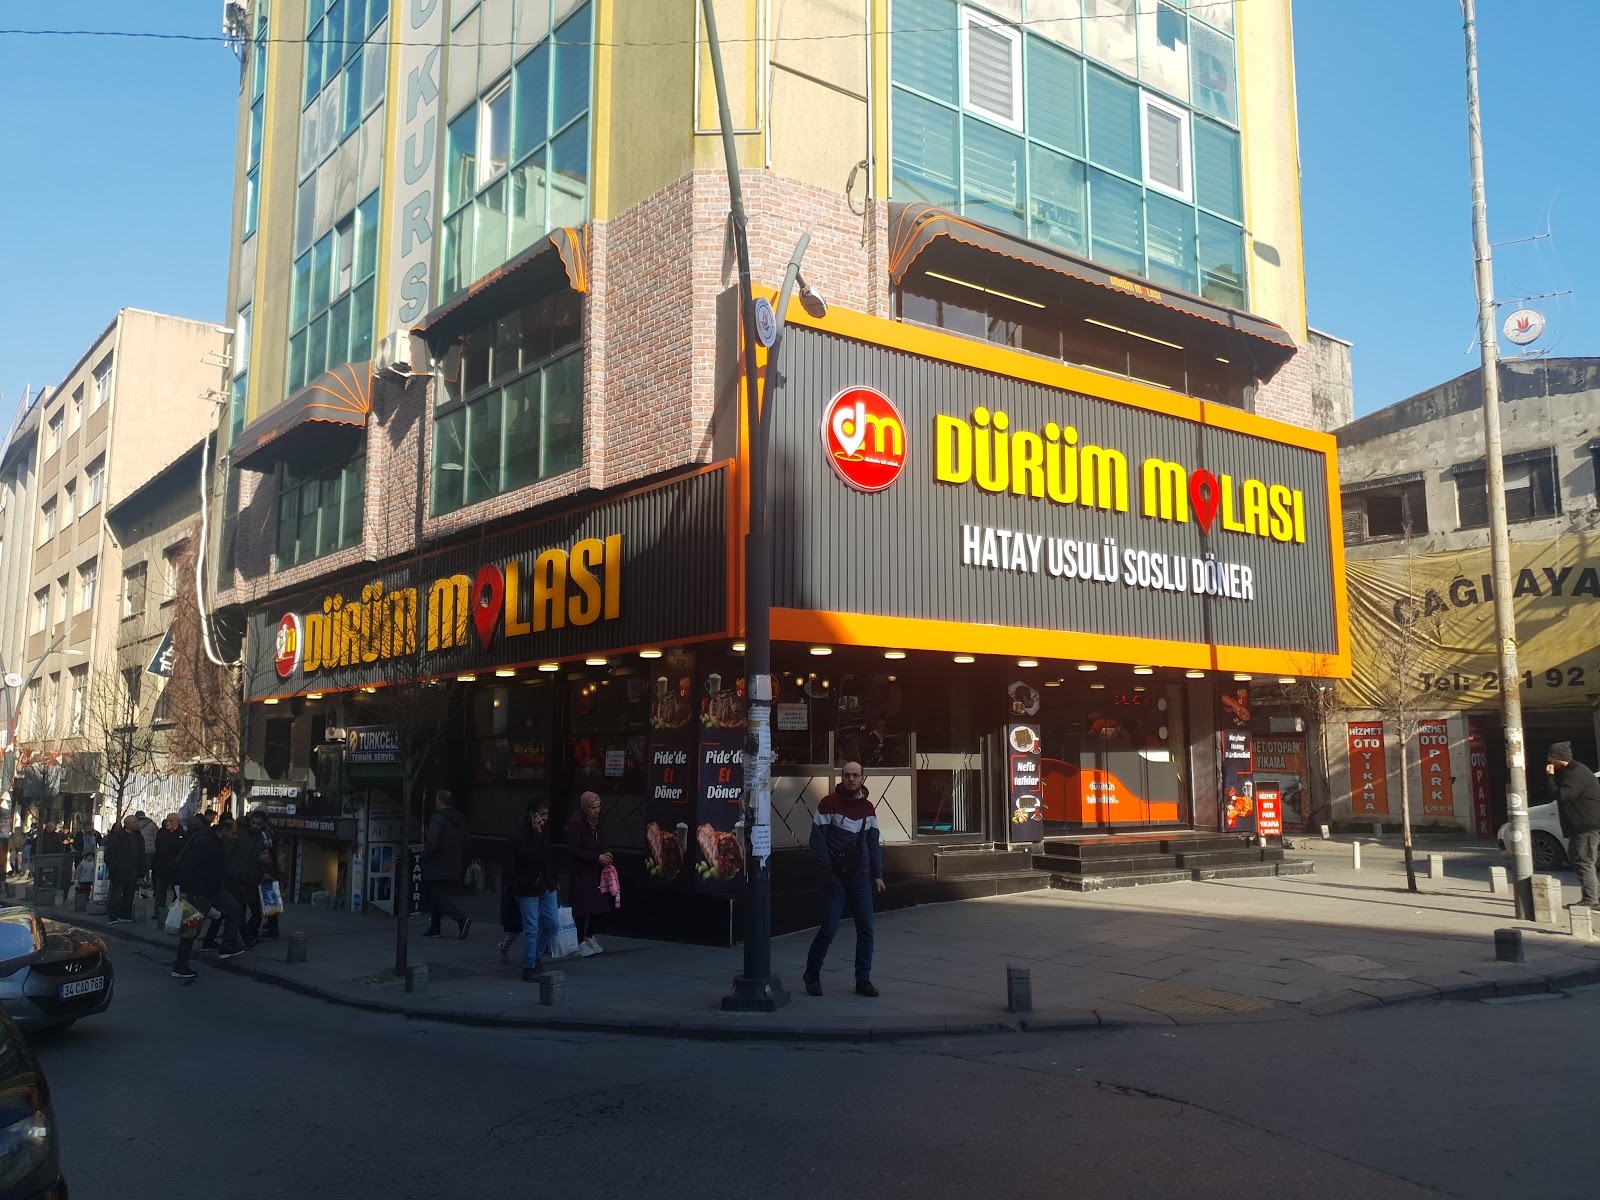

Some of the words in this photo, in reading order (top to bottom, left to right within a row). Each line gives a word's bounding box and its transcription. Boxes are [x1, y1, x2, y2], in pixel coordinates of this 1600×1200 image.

[934, 406, 1128, 513] DÜRÜM
[962, 524, 1042, 574] HATAY
[1048, 537, 1119, 583] USULÜ
[1123, 548, 1187, 593] SOSLU
[1192, 552, 1254, 600] DÖNER
[303, 581, 417, 672] DÜRÜM
[1545, 666, 1585, 687] 92
[1348, 726, 1383, 736] HİZMET
[1418, 723, 1447, 733] HİZMET
[1353, 738, 1380, 748] OTO
[1420, 735, 1448, 745] OTO
[1267, 741, 1301, 754] OTOPARK
[352, 752, 373, 762] TEKNİK
[374, 751, 395, 761] SERVİS
[653, 750, 687, 764] Pide'de
[1256, 756, 1286, 769] YIKAMA
[1471, 752, 1486, 767] OTO
[1017, 761, 1036, 772] Nefis
[663, 767, 676, 783] Et
[718, 767, 732, 783] Et
[1362, 752, 1375, 810] YIKAMA
[1429, 749, 1443, 800] PARK
[654, 785, 683, 799] Döner
[707, 785, 742, 799] Döner
[1476, 770, 1488, 834] PARK
[65, 984, 74, 996] 34
